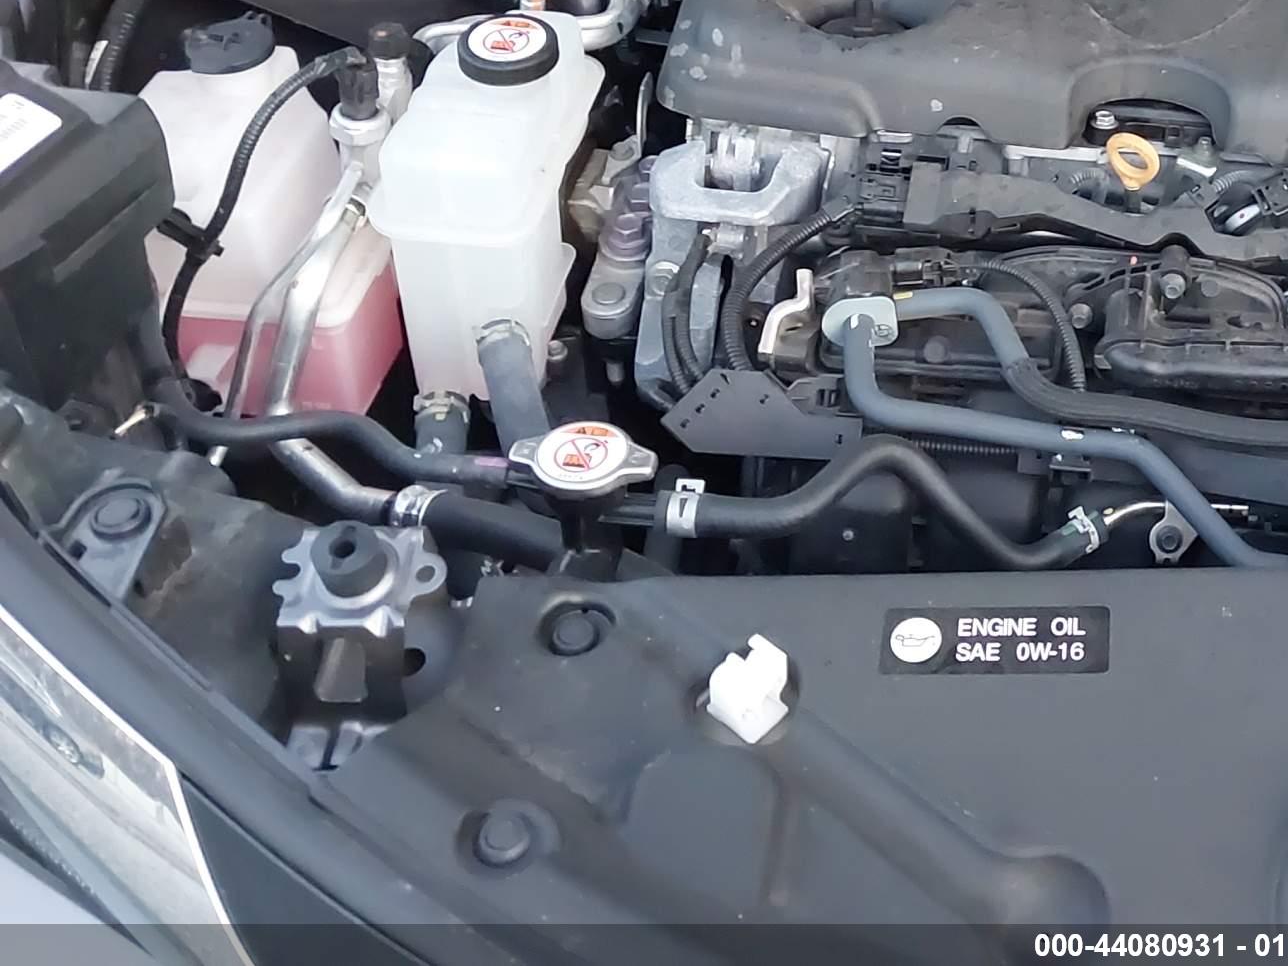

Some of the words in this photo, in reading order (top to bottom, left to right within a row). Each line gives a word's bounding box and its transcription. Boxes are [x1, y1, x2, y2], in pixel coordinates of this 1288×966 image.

[957, 617, 1038, 637] ENGINE
[1050, 617, 1086, 636] OIL
[955, 642, 1001, 662] SAE
[1016, 642, 1085, 661] 0W-16
